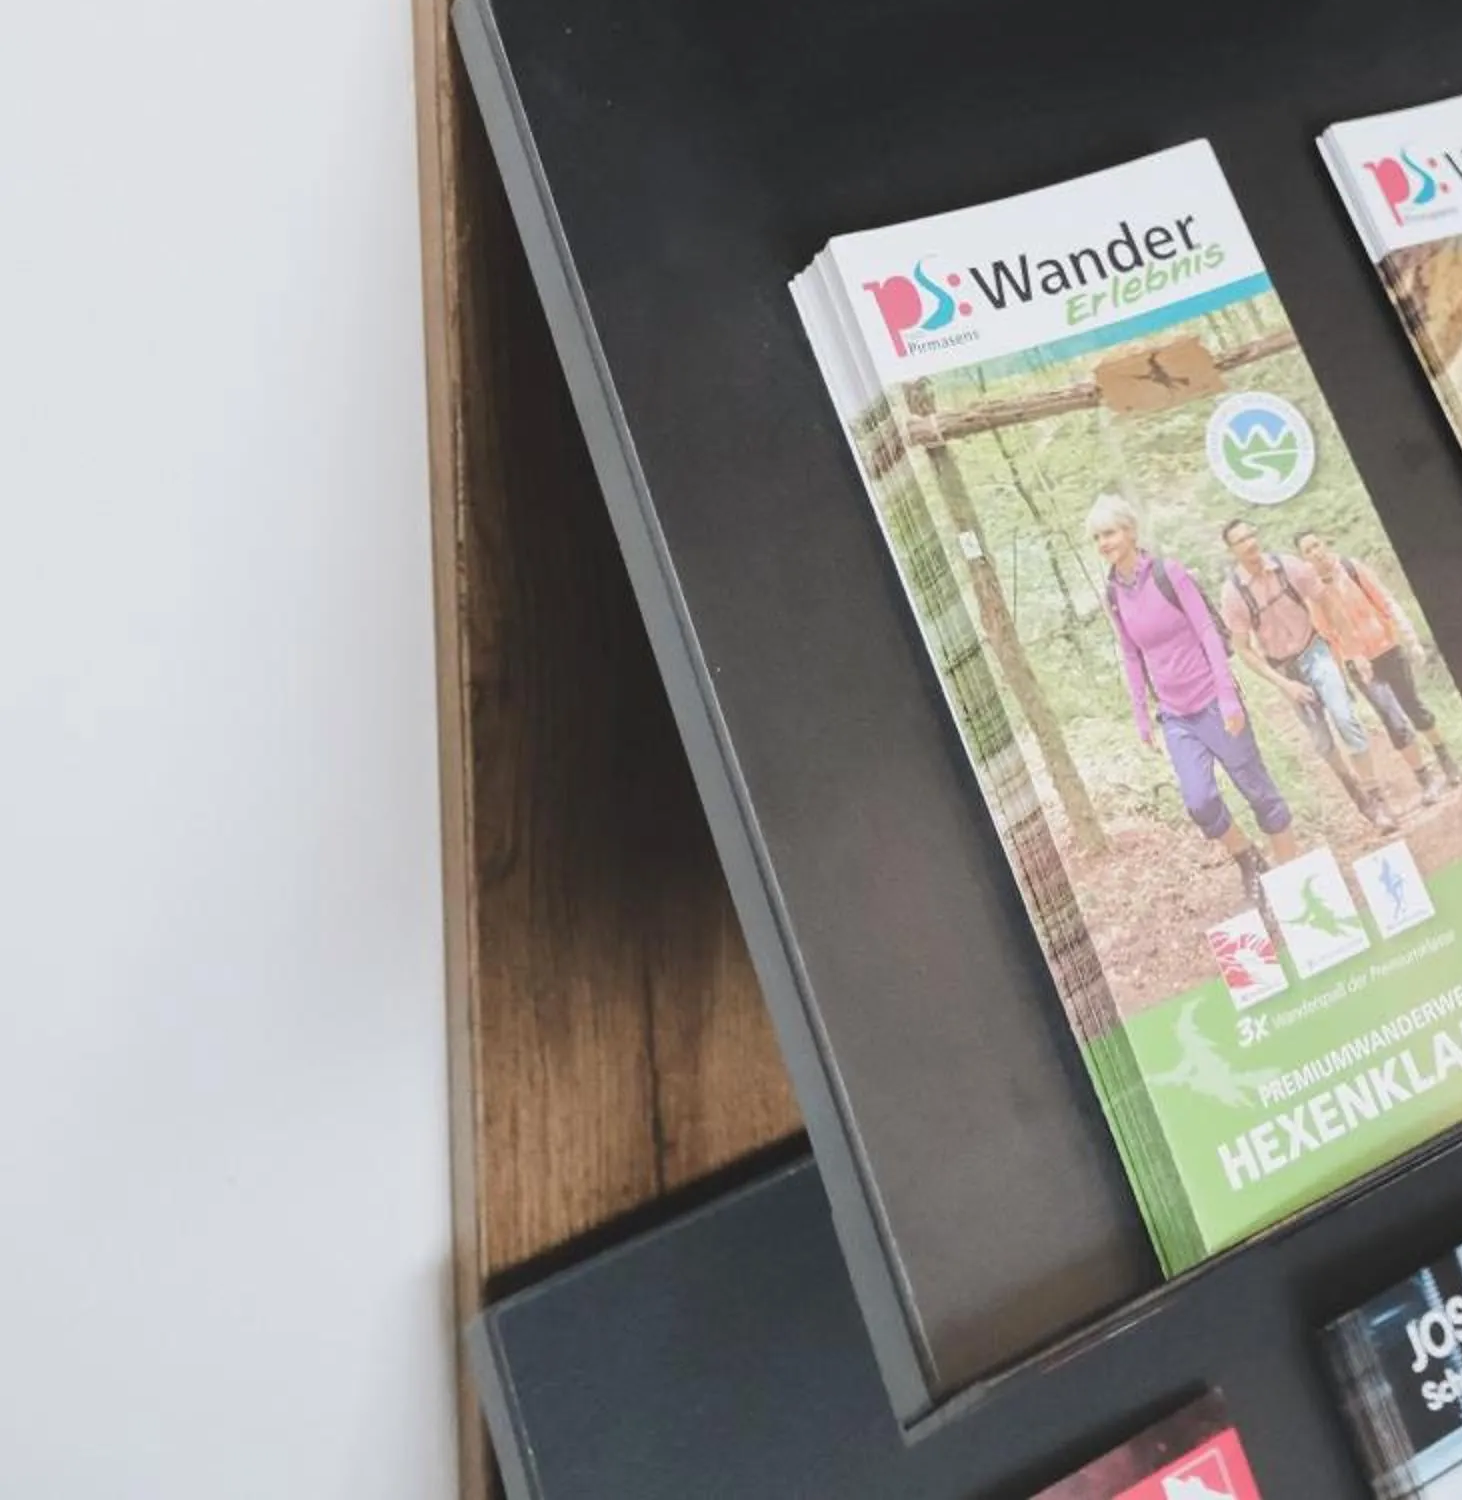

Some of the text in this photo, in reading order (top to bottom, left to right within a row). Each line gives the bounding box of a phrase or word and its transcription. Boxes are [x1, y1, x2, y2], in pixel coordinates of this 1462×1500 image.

[968, 211, 1203, 311] Wander
[1063, 239, 1227, 328] Erlebnis
[1235, 1012, 1271, 1048] 3x
